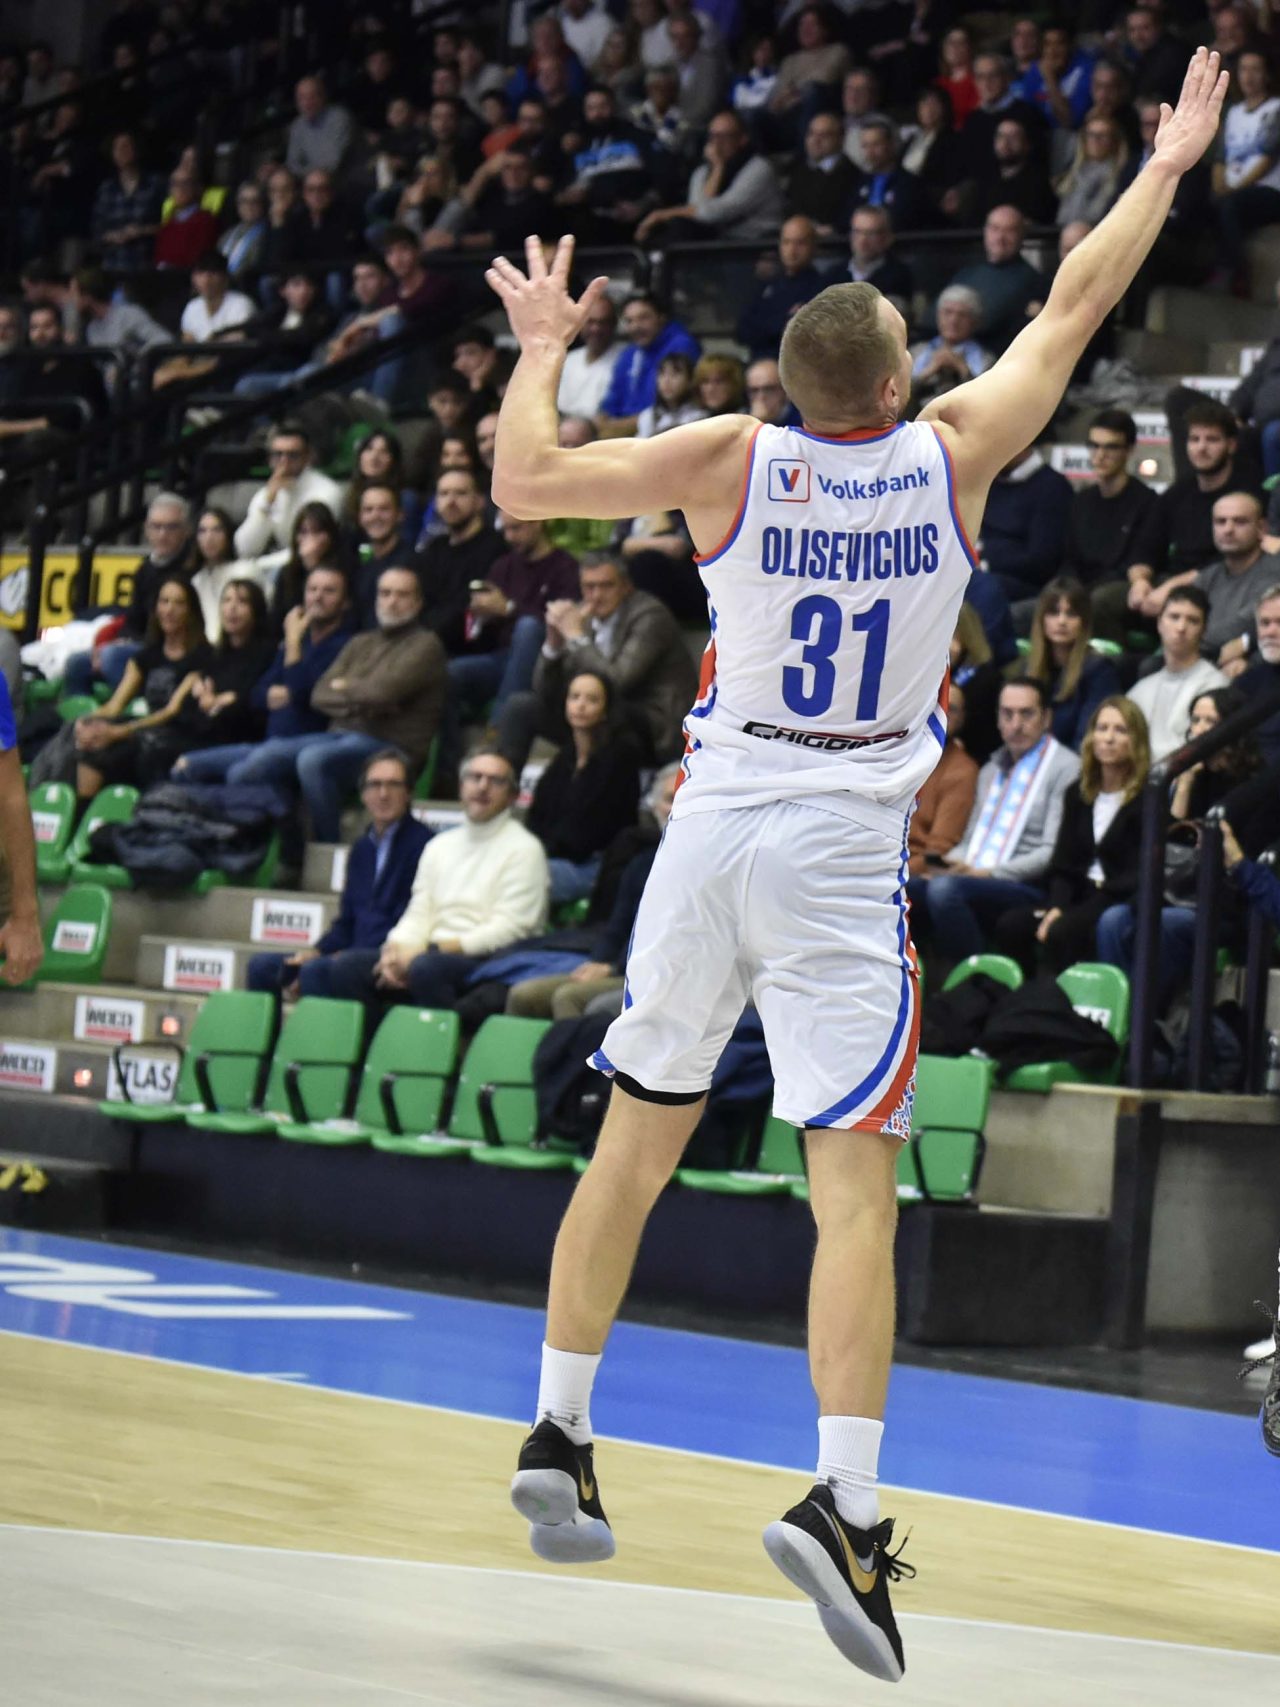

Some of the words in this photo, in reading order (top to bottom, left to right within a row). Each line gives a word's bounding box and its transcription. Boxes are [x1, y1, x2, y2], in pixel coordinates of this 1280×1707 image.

[818, 466, 930, 500] Volksbank
[761, 522, 939, 582] OLISEVICIUS
[782, 593, 891, 722] 31
